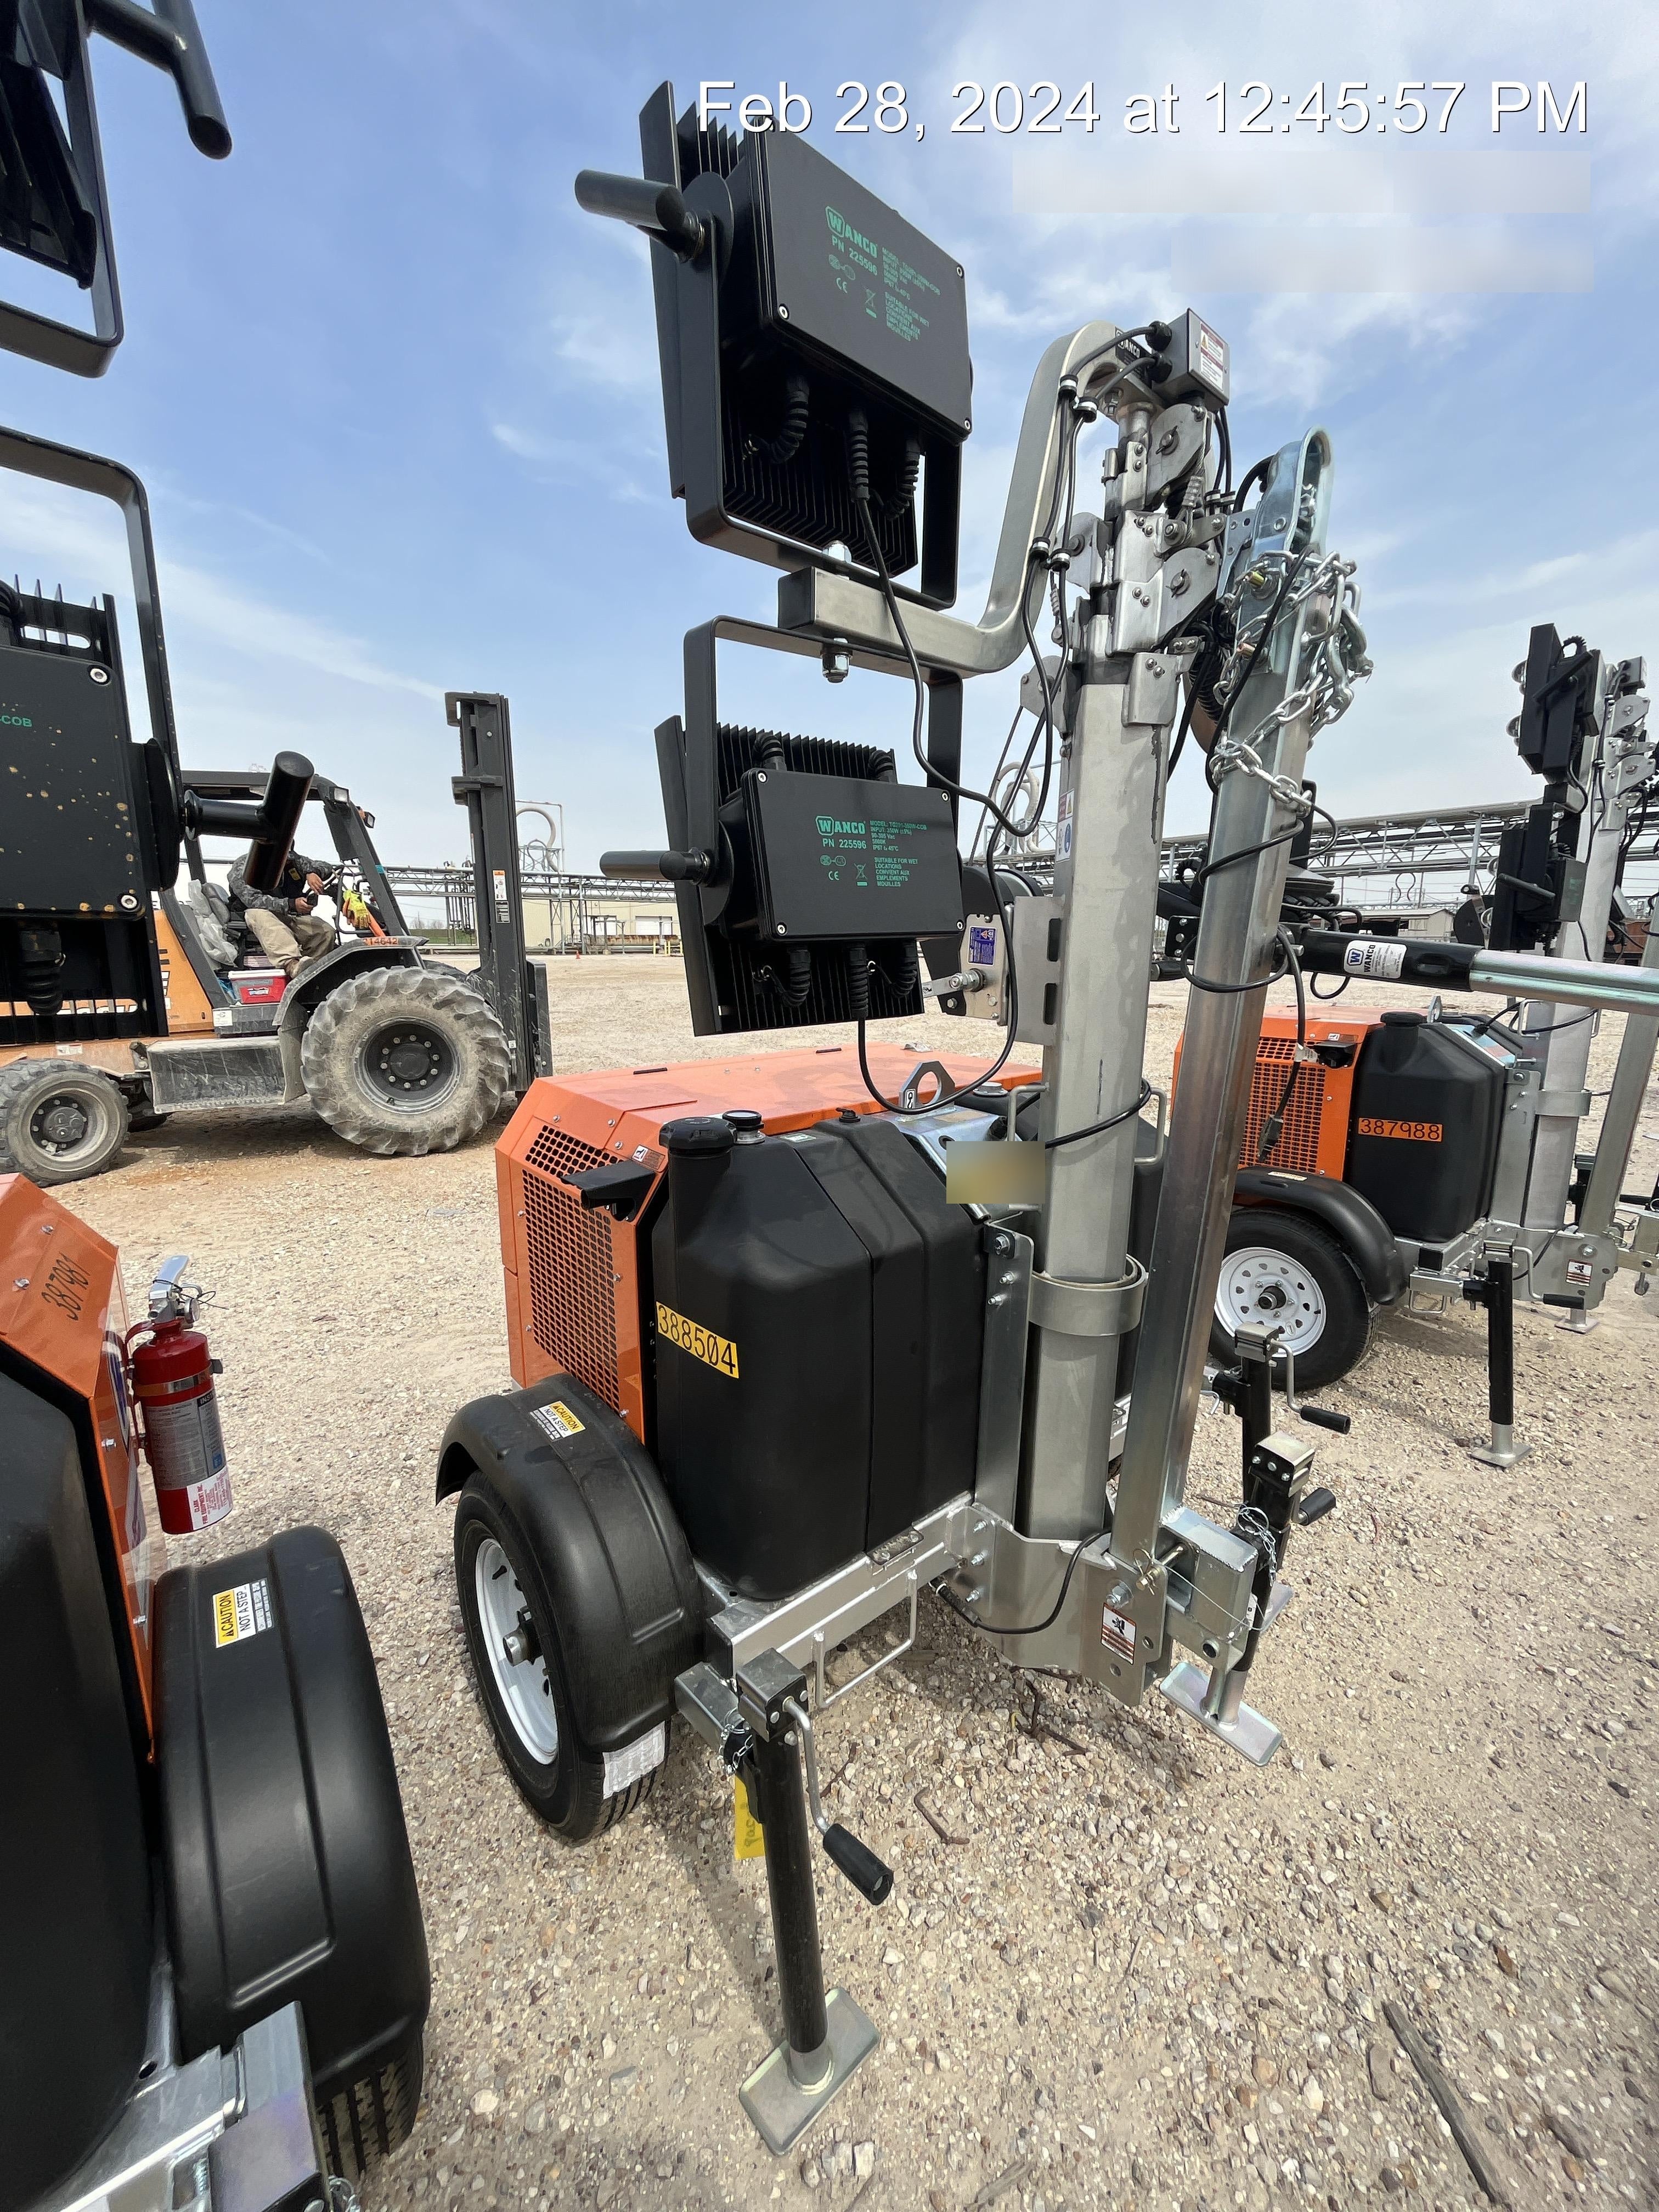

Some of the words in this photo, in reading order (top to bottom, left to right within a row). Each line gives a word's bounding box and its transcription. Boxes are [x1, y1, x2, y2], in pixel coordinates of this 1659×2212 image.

[825, 206, 878, 259] WANCO
[832, 234, 844, 253] PN
[849, 247, 878, 276] 225596
[815, 815, 866, 836] WANCO
[822, 838, 835, 848] PN
[838, 839, 867, 850] 225596
[1364, 944, 1376, 973] WANCO
[1360, 1118, 1441, 1141] 387988
[658, 1304, 736, 1374] 388504
[555, 1420, 568, 1432] STEP
[556, 1407, 579, 1430] CAUTION
[236, 1590, 249, 1608] STEP
[219, 1593, 235, 1631] CAUTION
[239, 1614, 251, 1632] NOT
